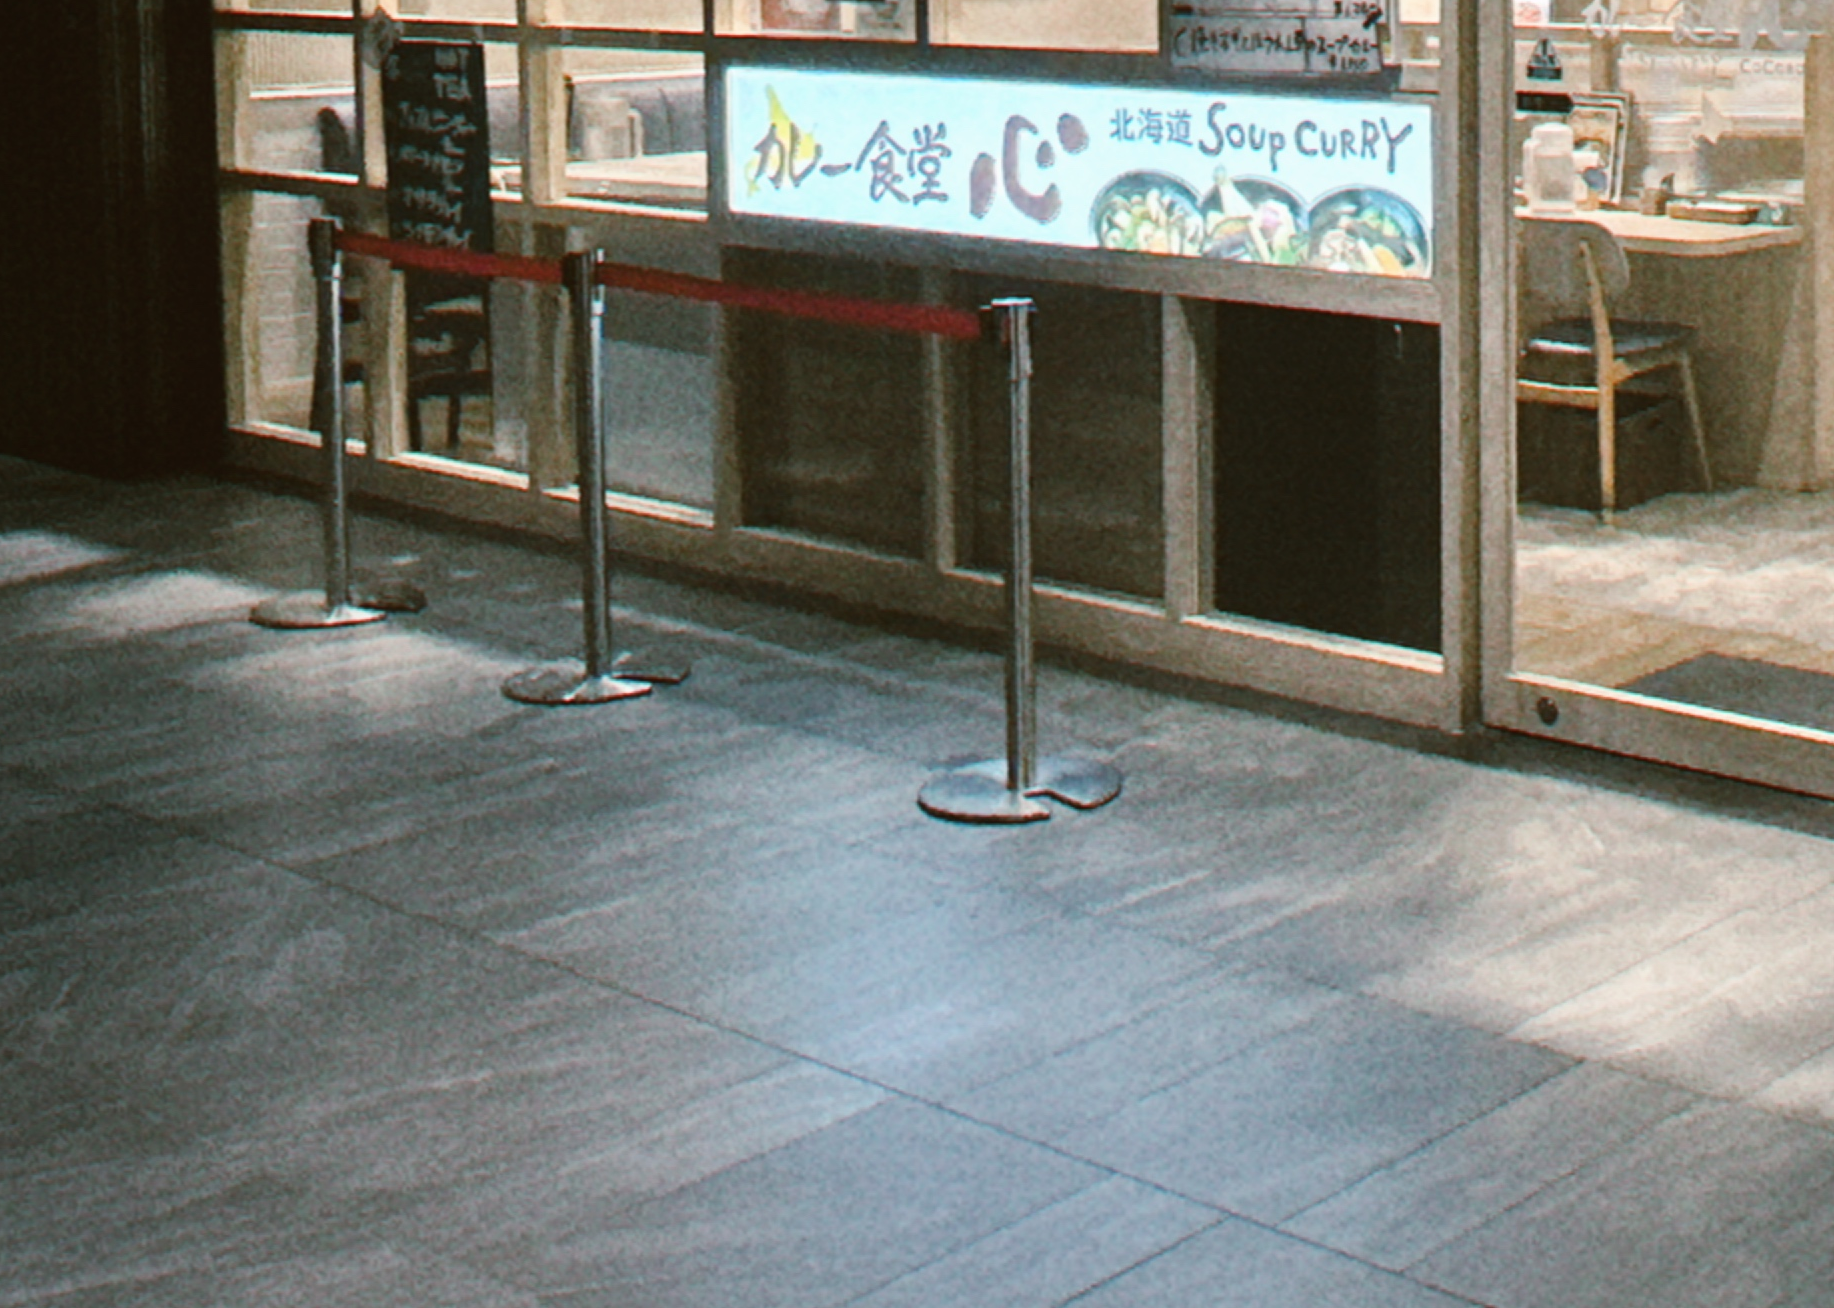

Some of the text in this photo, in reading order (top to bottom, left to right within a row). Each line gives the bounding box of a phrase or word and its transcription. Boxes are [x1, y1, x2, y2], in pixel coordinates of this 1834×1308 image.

[1110, 107, 1193, 148] 北海道
[753, 111, 1089, 224] カレー食堂 心
